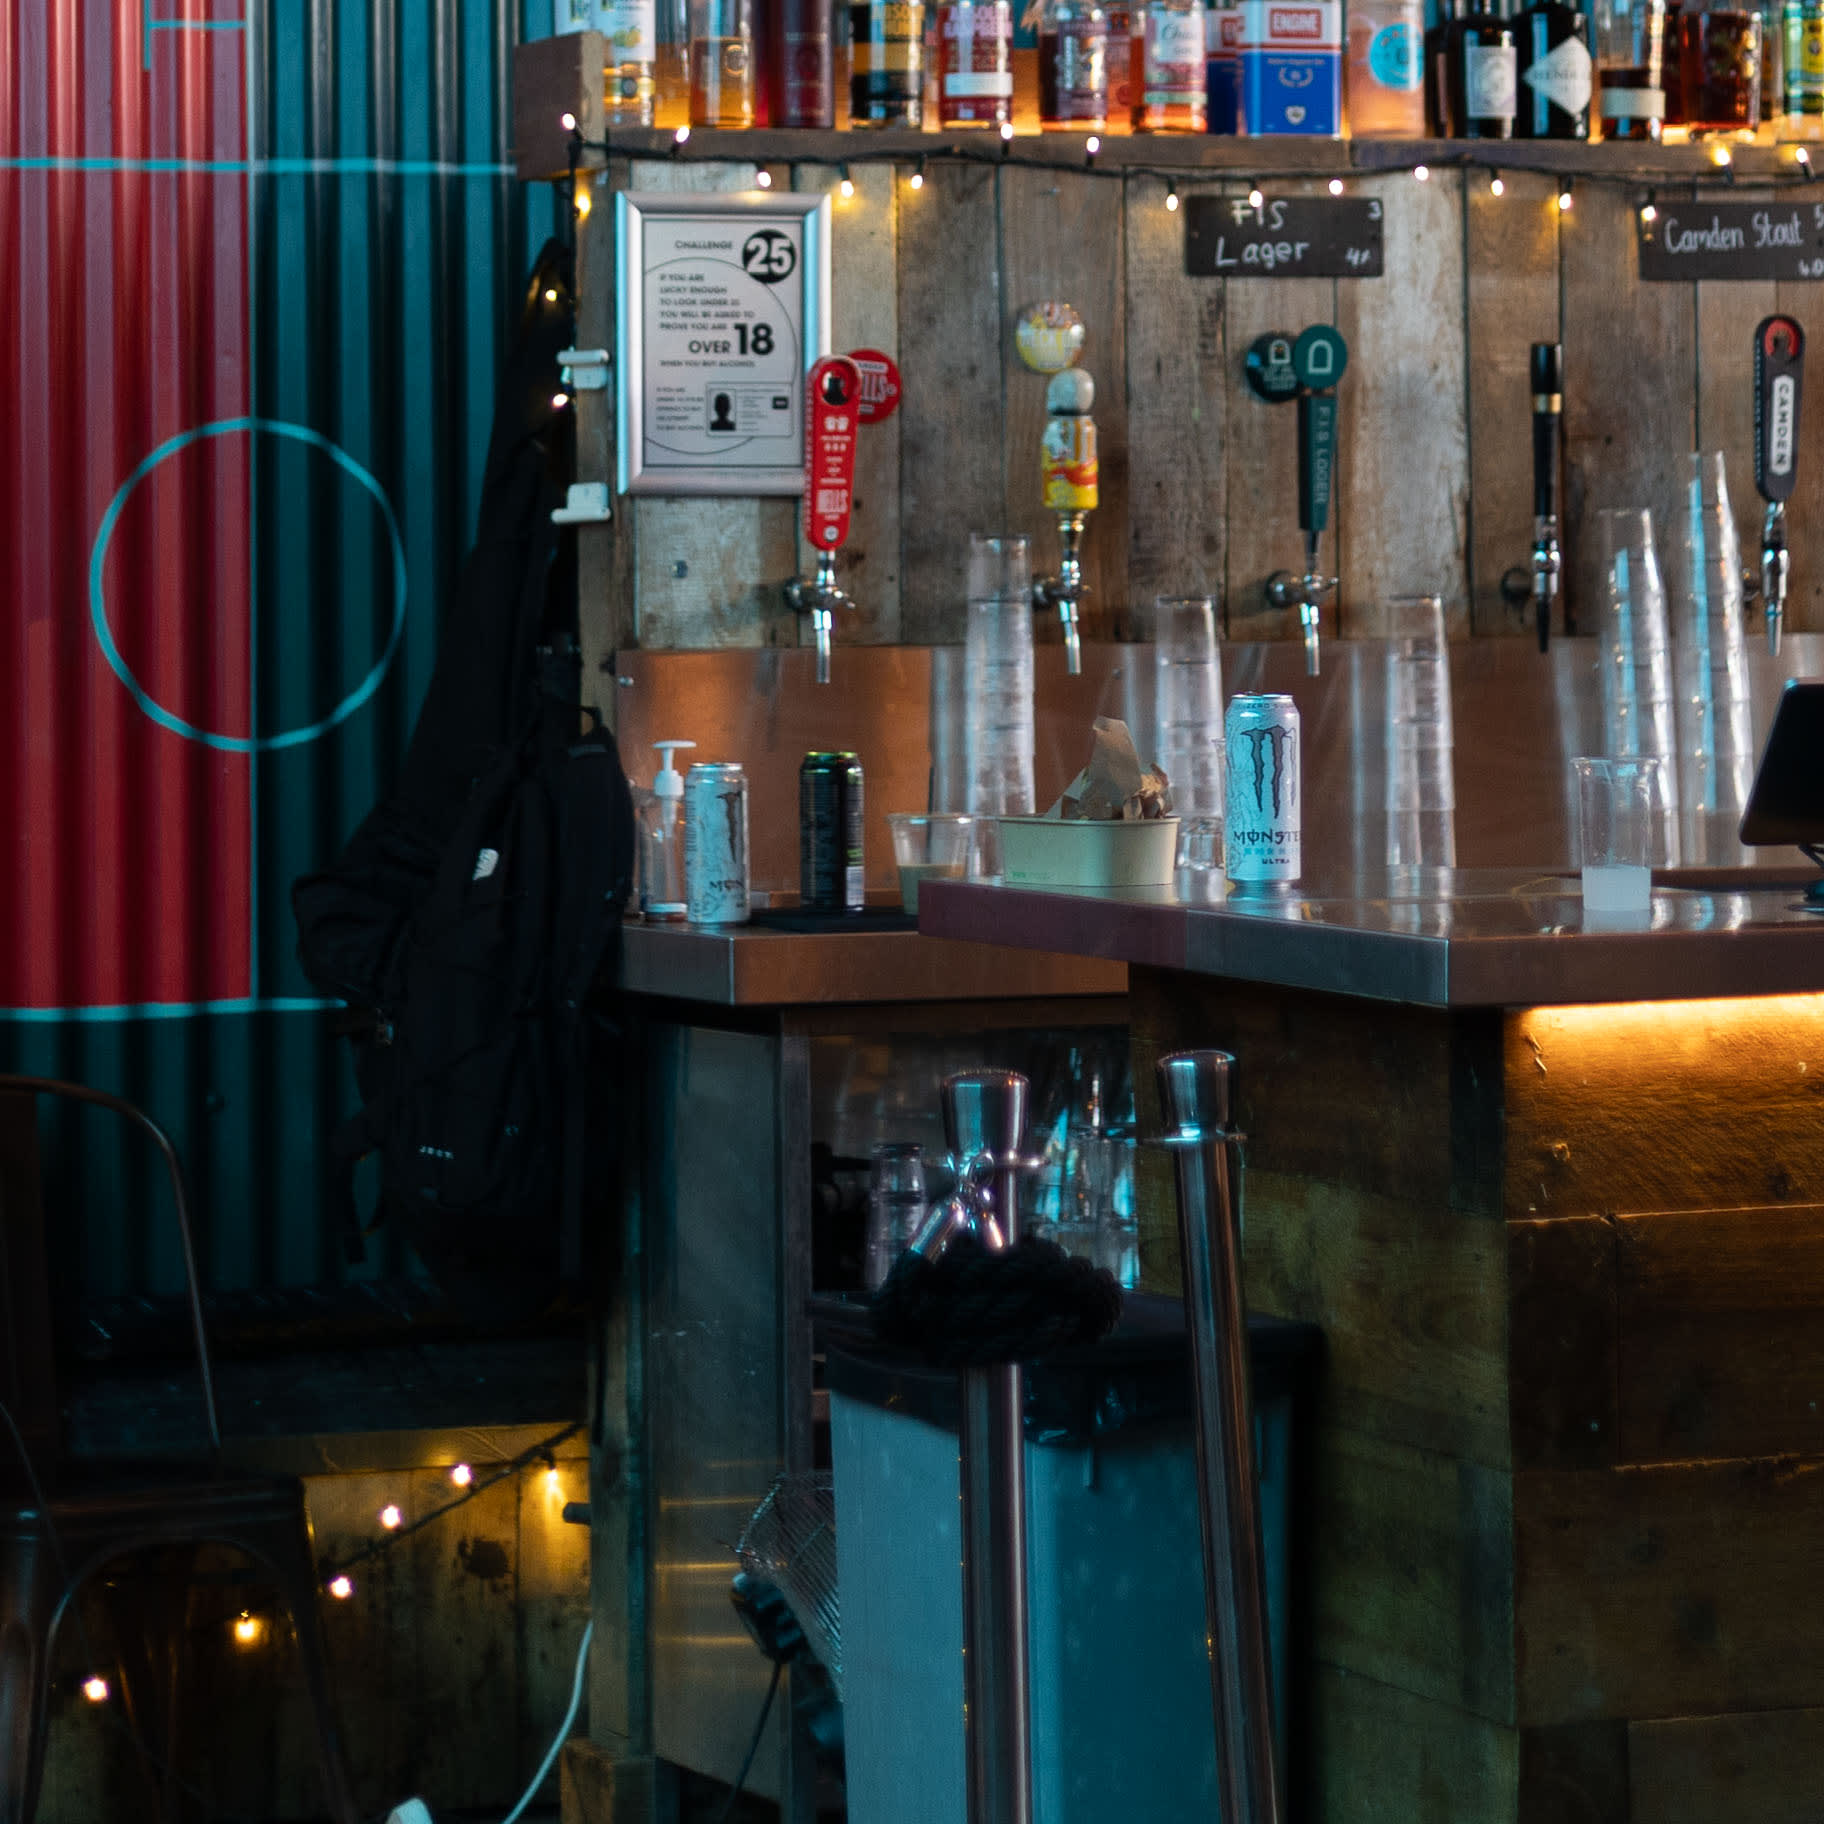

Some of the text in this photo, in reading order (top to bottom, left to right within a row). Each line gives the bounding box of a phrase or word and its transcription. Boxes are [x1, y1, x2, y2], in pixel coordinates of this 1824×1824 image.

[1664, 217, 1744, 255] Camden
[1752, 210, 1804, 249] Stout
[674, 237, 793, 275] CHALLENGE 25
[1215, 236, 1310, 270] Lager
[690, 286, 727, 294] ENOUGH
[688, 323, 774, 356] OVER 18
[1776, 383, 1790, 465] CAMDEN
